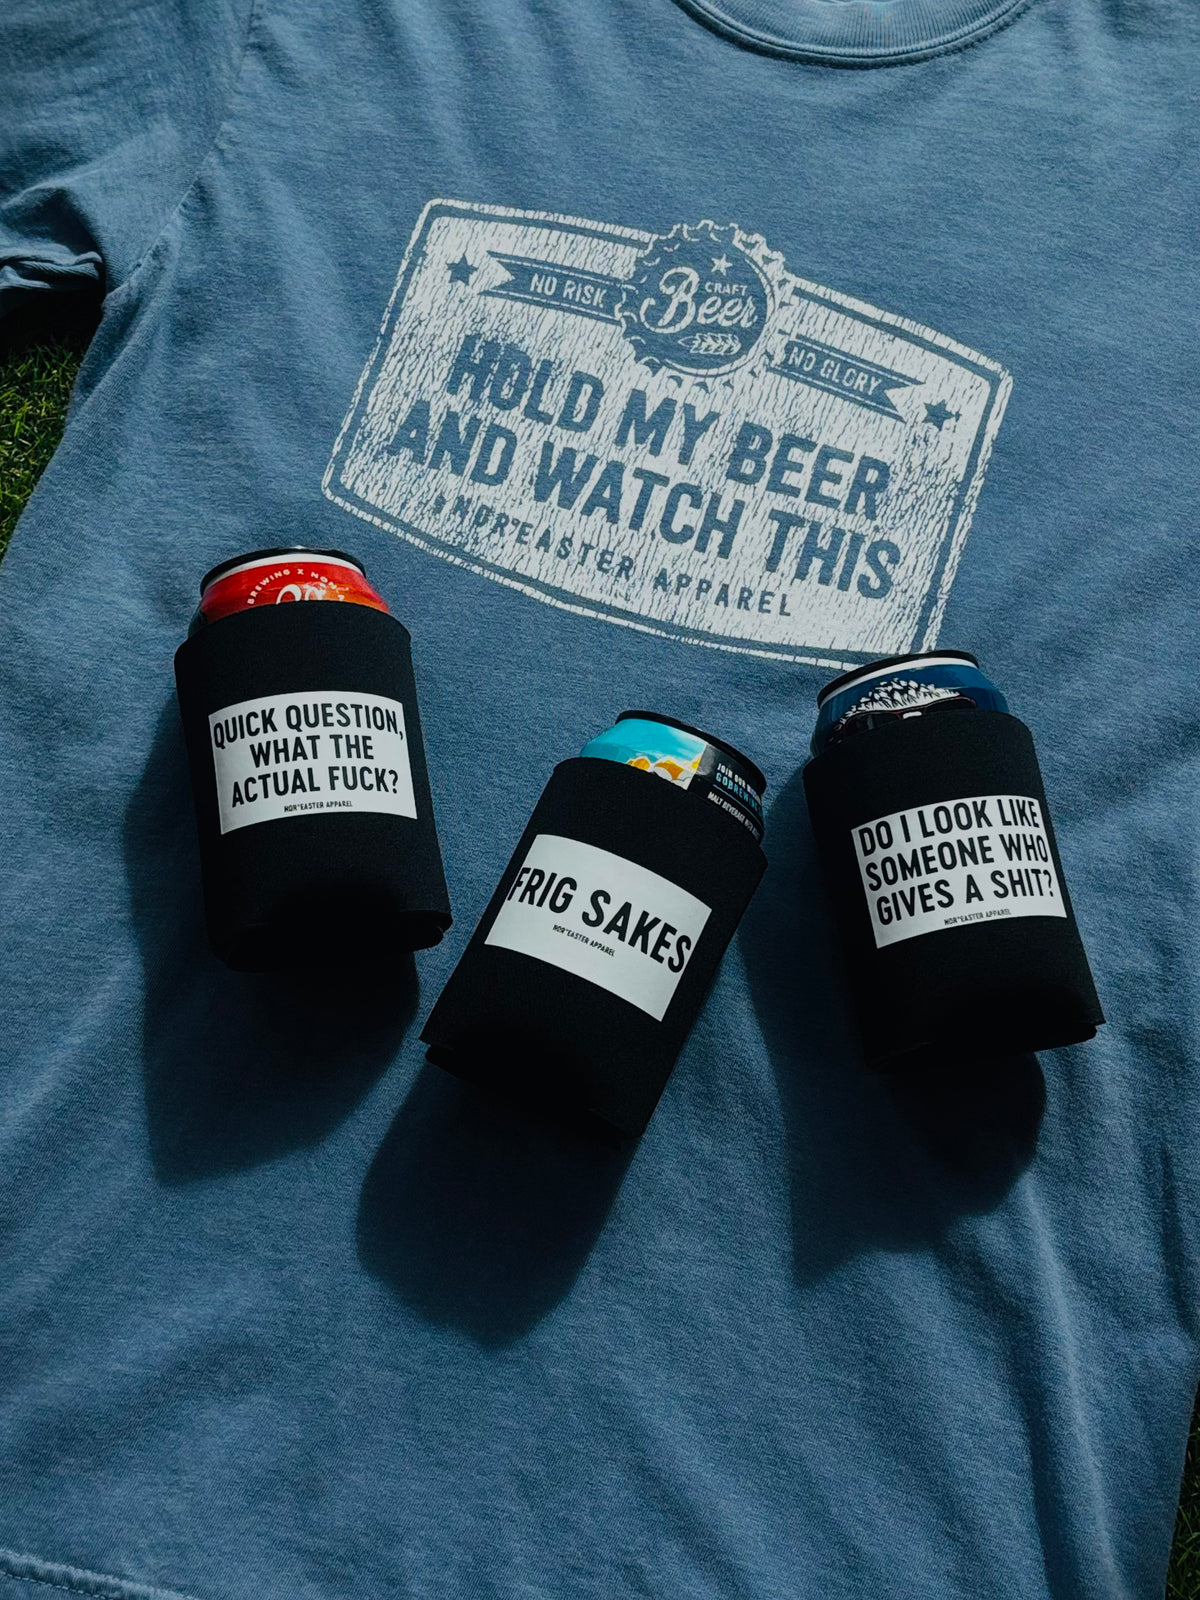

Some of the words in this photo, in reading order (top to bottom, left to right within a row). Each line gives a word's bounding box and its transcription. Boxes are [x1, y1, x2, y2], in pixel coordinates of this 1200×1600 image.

[529, 273, 557, 296] NO
[562, 281, 608, 310] RISK
[639, 266, 758, 334] Beer
[704, 281, 748, 297] CRAFT
[788, 345, 815, 369] NO
[819, 356, 883, 397] GLORY
[446, 333, 605, 434] HOLD
[614, 388, 722, 466] MY
[725, 421, 892, 521] BEER
[386, 399, 518, 486] AND
[533, 440, 746, 560] WATCH
[768, 508, 902, 600] THIS
[247, 568, 290, 605] BREWING
[296, 568, 304, 576] X
[653, 566, 793, 616] APPAREL
[213, 707, 278, 750] QUICK
[285, 703, 404, 741] QUESTION,
[249, 735, 320, 769] WHAT
[329, 735, 375, 760] THE
[231, 767, 321, 808] ACTUAL
[328, 766, 399, 794] FUCK?
[326, 800, 353, 808] APPAREL
[707, 791, 724, 806] MALT
[858, 820, 894, 857] DO
[900, 814, 911, 843] I
[917, 799, 993, 838] LOOK
[996, 798, 1040, 828] LIKE
[865, 835, 995, 892] SOMEONE
[998, 833, 1049, 863] WHO
[507, 867, 578, 914] FRIG
[581, 889, 692, 974] SAKES
[876, 879, 955, 926] GIVES
[965, 874, 985, 904] A
[990, 868, 1054, 899] SHIT?
